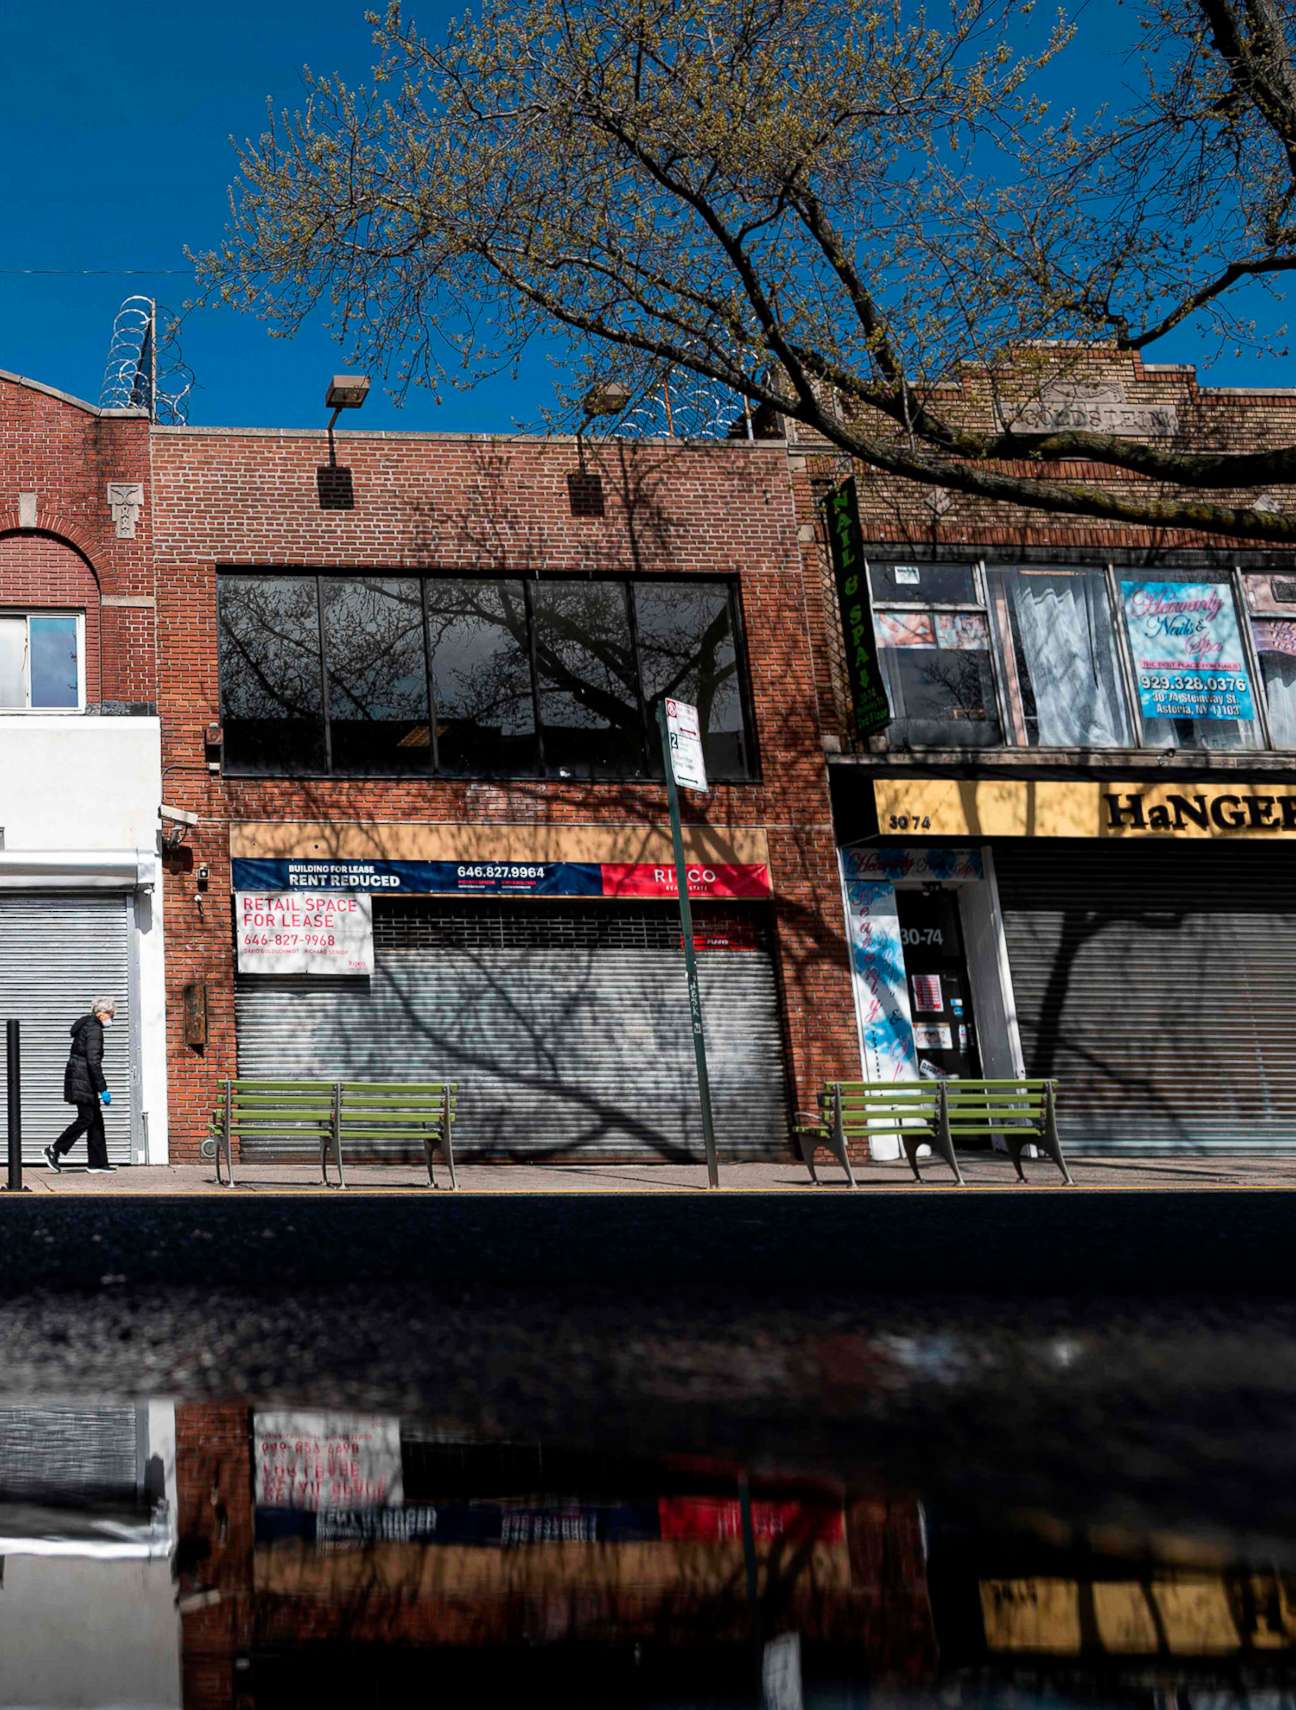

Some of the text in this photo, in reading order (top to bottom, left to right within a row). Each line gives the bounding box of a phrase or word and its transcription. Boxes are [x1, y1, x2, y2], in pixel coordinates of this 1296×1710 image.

[1140, 675, 1247, 692] 929.328.0376
[288, 865, 375, 874] BUILDING FOR LEASE
[457, 866, 545, 879] 646.827.9964
[654, 869, 716, 883] RICO
[289, 874, 401, 887] RENT REDUCED
[243, 897, 358, 913] RETAIL SPACE
[243, 913, 335, 928] FOR LEASE
[243, 933, 336, 947] 646-827-9968
